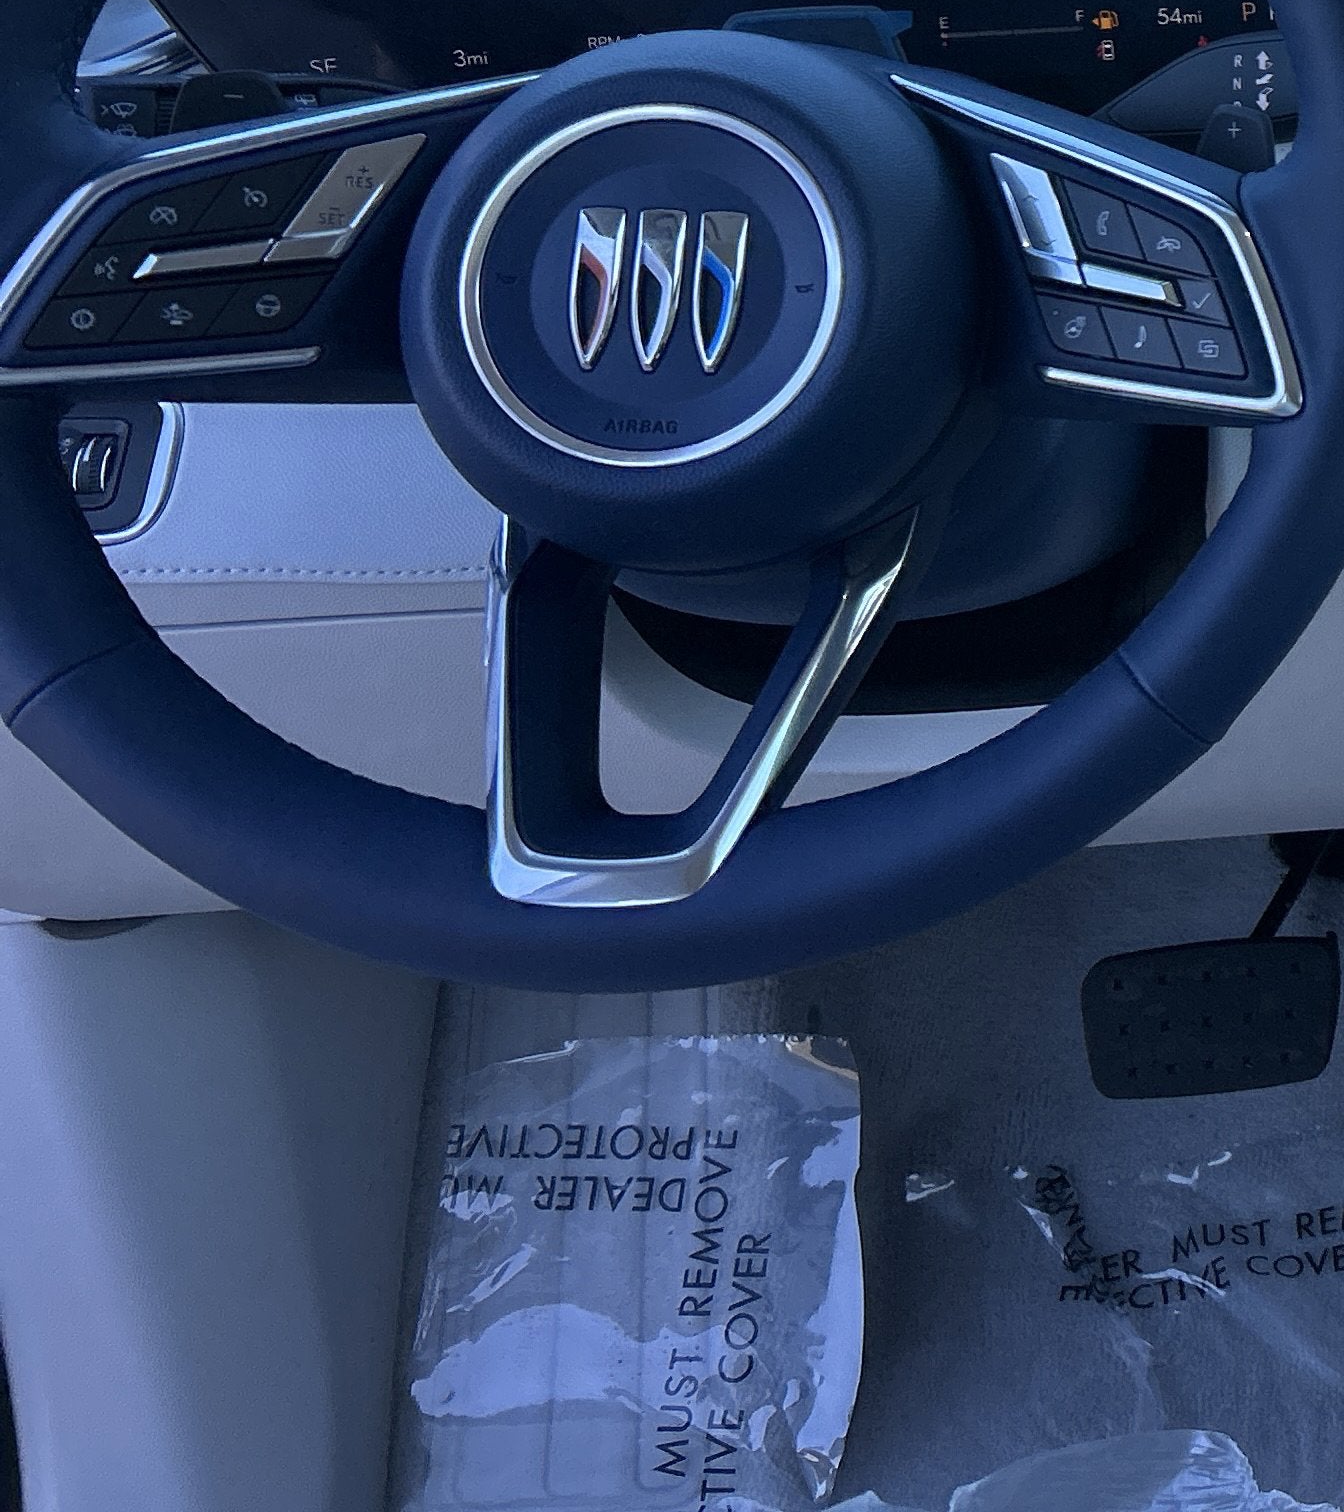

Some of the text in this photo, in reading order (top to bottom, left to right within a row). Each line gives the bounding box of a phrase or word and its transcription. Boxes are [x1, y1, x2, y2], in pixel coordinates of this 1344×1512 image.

[1075, 9, 1086, 22] F
[1157, 7, 1203, 26] 54mi
[1241, 1, 1256, 22] P
[938, 16, 949, 30] E
[453, 49, 489, 68] 3mi
[1233, 54, 1243, 67] R
[1232, 77, 1242, 91] N
[345, 175, 374, 188] RES
[319, 212, 346, 226] SET
[603, 418, 679, 436] AIRBAG
[445, 1123, 695, 1161] PROTECTIVE
[533, 1174, 687, 1213] DEALER
[1171, 1218, 1272, 1263] MUST
[652, 1128, 738, 1479] MUST REMOVE
[717, 1231, 773, 1384] COVER
